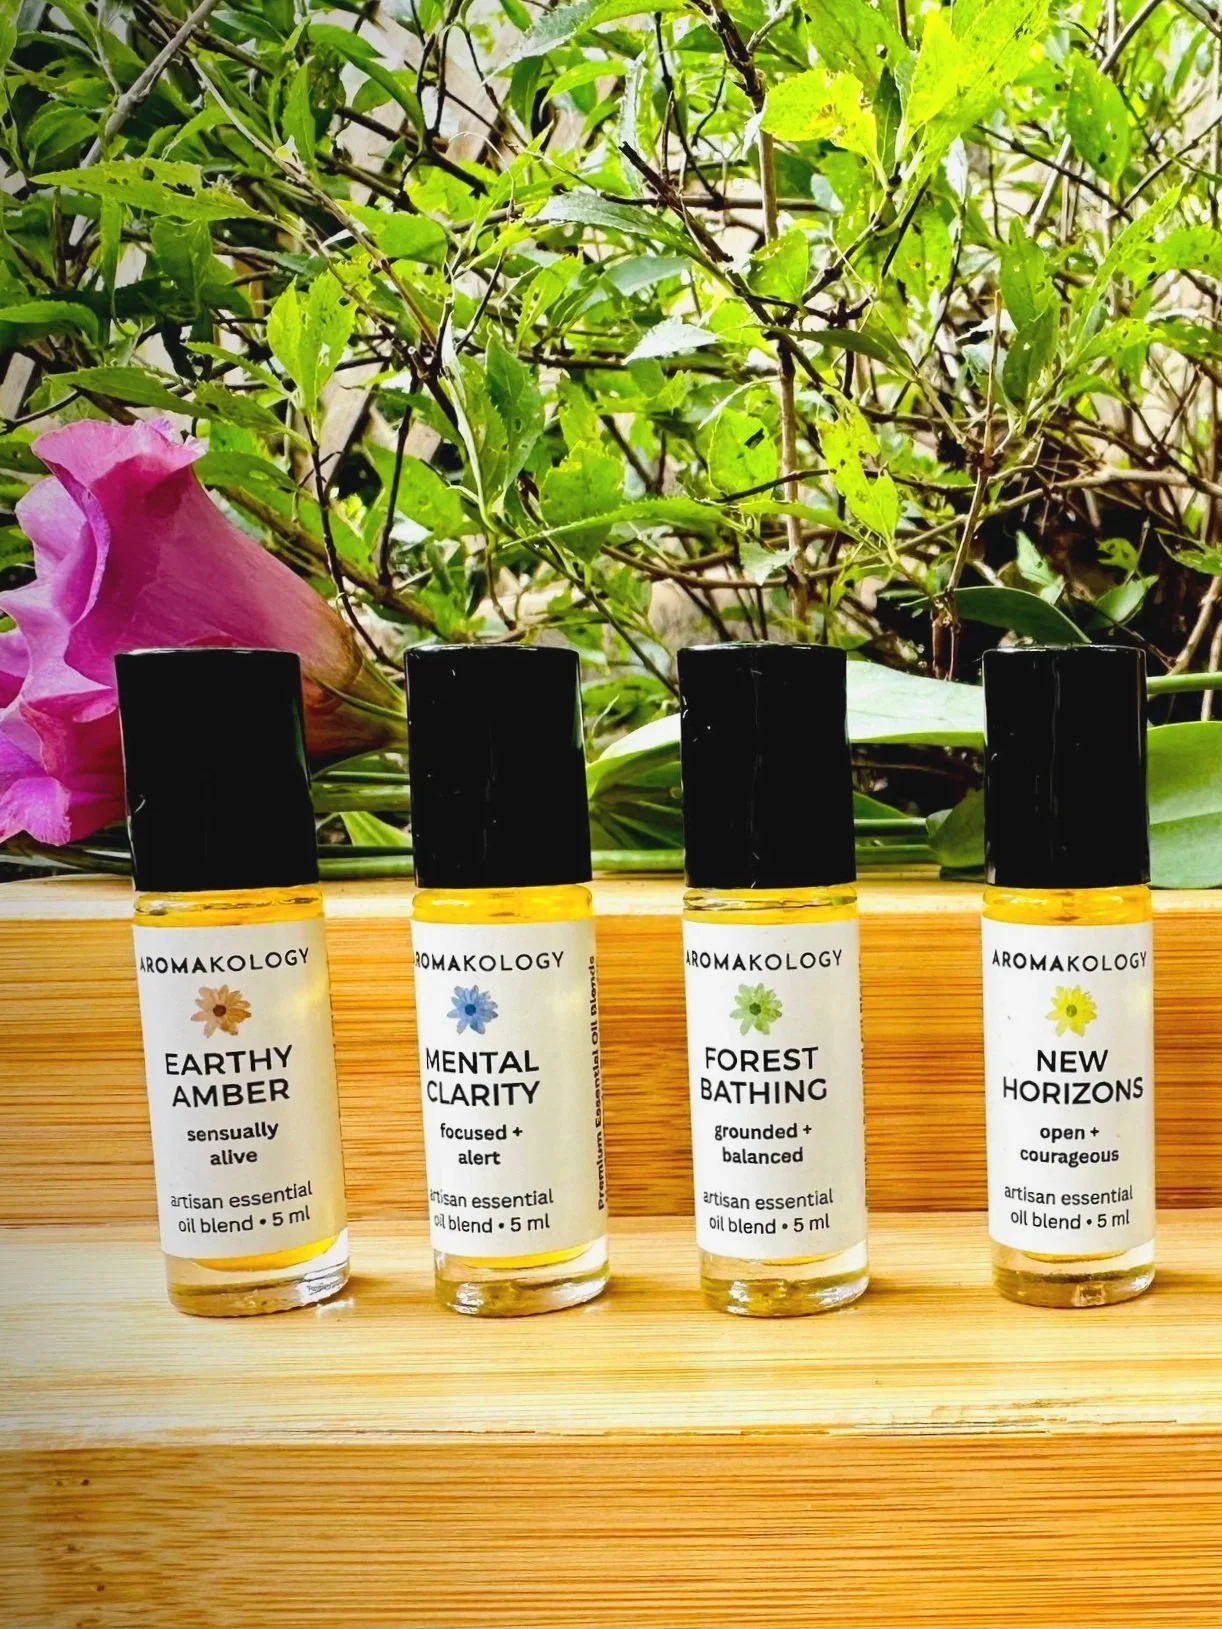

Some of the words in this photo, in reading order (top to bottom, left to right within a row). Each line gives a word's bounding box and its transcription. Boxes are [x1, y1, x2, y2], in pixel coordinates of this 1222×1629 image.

[140, 948, 309, 974] AROMAKOLOGY
[413, 951, 564, 972] ROMAKOLOGY
[686, 949, 842, 971] AROMAKOLOGY
[992, 949, 1147, 972] AROMAKOLOGY
[165, 1045, 292, 1075] EARTHY
[426, 1049, 539, 1073] MENTAL
[705, 1047, 818, 1073] FOREST
[1036, 1050, 1108, 1073] NEW
[172, 1078, 290, 1108] AMBER
[427, 1081, 540, 1106] CLARITY
[701, 1077, 827, 1104] BATHING
[1003, 1077, 1144, 1105] HORIZONS
[187, 1122, 279, 1141] sensually
[440, 1125, 507, 1140] focused
[512, 1127, 523, 1137] +
[715, 1123, 797, 1141] grounded
[802, 1124, 812, 1134] +
[1040, 1127, 1085, 1143] open
[1090, 1127, 1100, 1137] +
[210, 1150, 258, 1165] alive
[458, 1151, 501, 1165] alert
[722, 1147, 803, 1164] balanced
[1020, 1149, 1119, 1167] courageous
[171, 1193, 223, 1209] artisan
[229, 1182, 312, 1208] essential
[430, 1190, 467, 1208] artisan
[472, 1189, 554, 1208] essential
[703, 1190, 750, 1209] artisan
[755, 1188, 833, 1210] essential
[1004, 1185, 1055, 1205] artisan
[1061, 1185, 1133, 1205] essential
[178, 1218, 195, 1233] oil
[201, 1215, 253, 1233] blend
[272, 1212, 283, 1227] 5
[288, 1206, 310, 1223] ml
[434, 1214, 445, 1230] oil
[448, 1217, 493, 1233] blend
[510, 1217, 521, 1232] 5
[527, 1214, 550, 1230] ml
[709, 1216, 724, 1232] oil
[728, 1217, 776, 1234] blend
[793, 1217, 804, 1232] 5
[809, 1214, 830, 1230] ml
[1011, 1209, 1027, 1226] oil
[1032, 1212, 1081, 1229] blend
[1097, 1214, 1107, 1228] 5
[1112, 1210, 1130, 1227] ml
